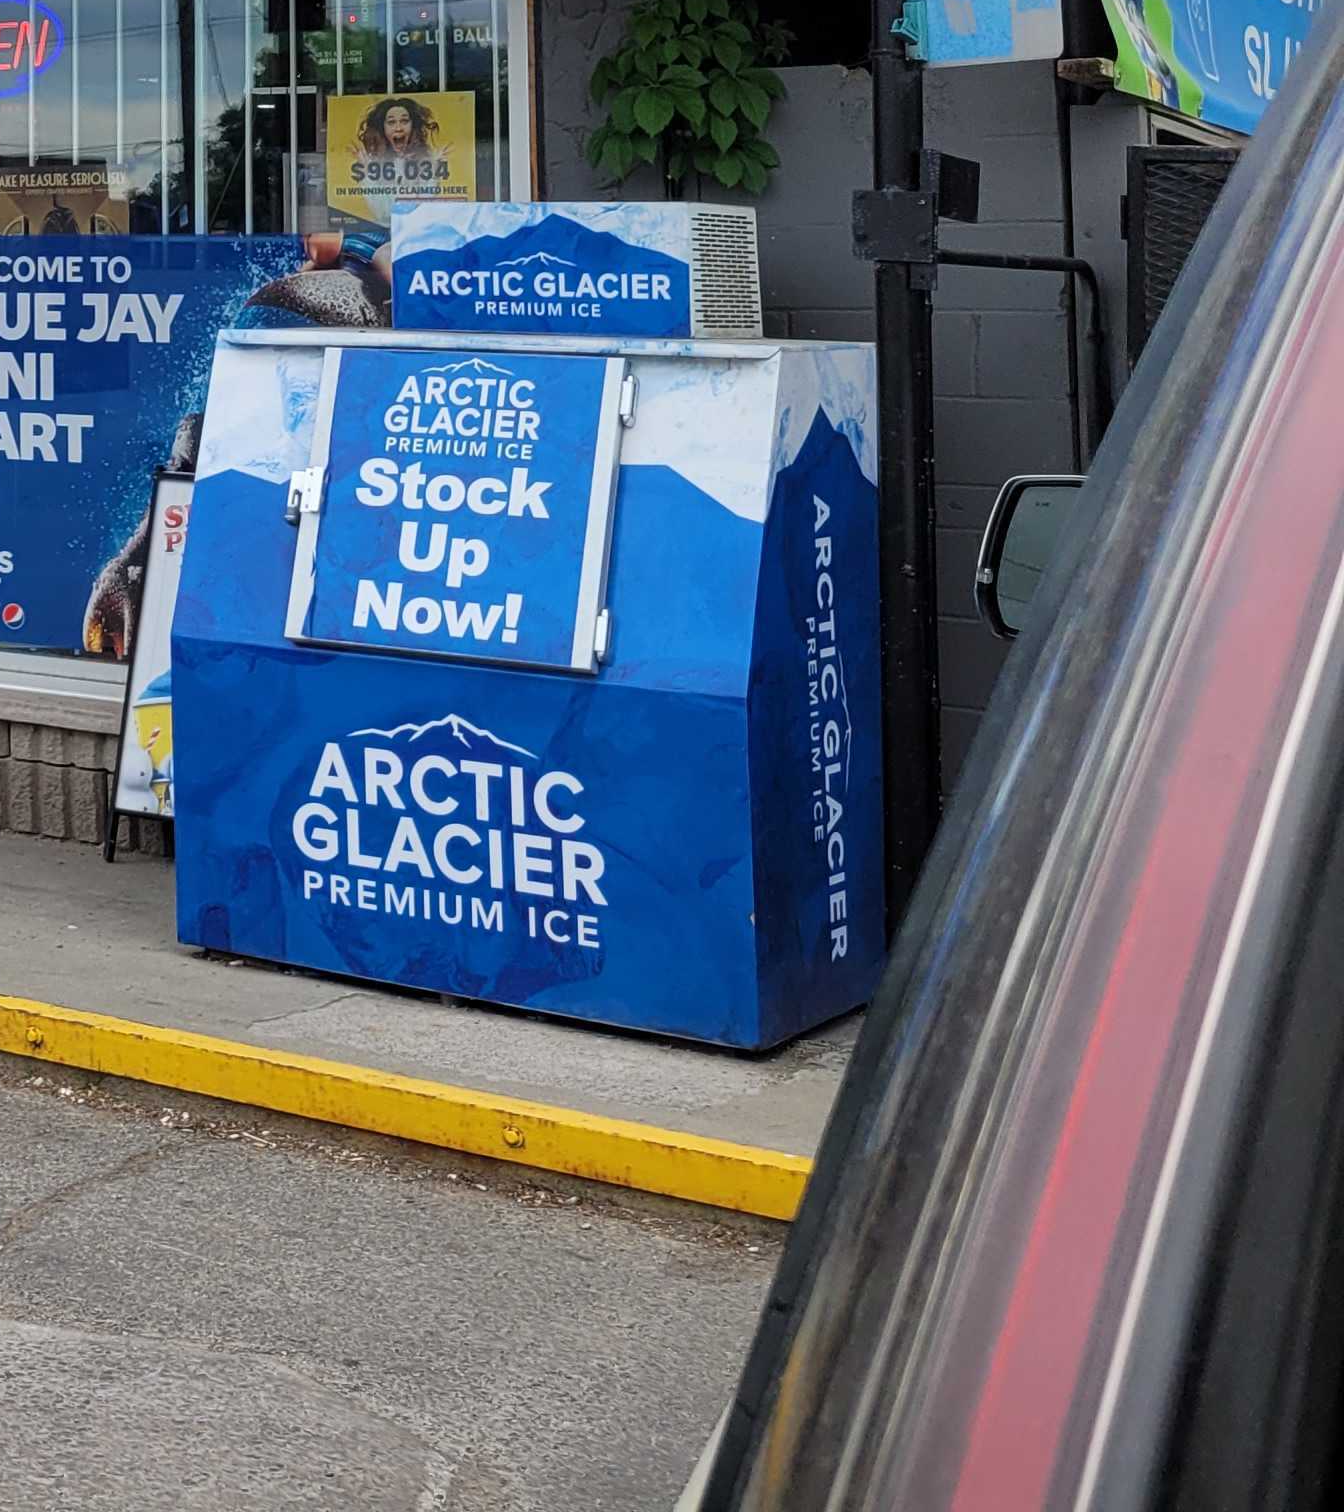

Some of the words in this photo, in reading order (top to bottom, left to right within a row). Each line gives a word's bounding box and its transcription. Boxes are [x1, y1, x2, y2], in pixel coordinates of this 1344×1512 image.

[19, 172, 69, 188] PLEASURE
[336, 187, 347, 196] IN
[348, 186, 397, 196] WINNINGS
[398, 186, 442, 195] CLAIMED
[443, 185, 468, 195] HERE
[350, 159, 450, 183] $96,034
[90, 256, 132, 284] TO
[408, 270, 524, 299] ARCTIC
[533, 272, 672, 300] GLACIER
[77, 292, 185, 344] JAY
[474, 300, 563, 318] PREMIUM
[570, 302, 602, 319] ICE
[396, 374, 536, 409] ARCTIC
[383, 403, 541, 441] GLACIER
[385, 436, 487, 458] PREMIUM
[496, 442, 533, 461] ICE
[355, 457, 553, 520] Stock
[398, 520, 490, 589] Up
[351, 579, 524, 644] Now!
[813, 493, 838, 702] ARCTIC
[805, 615, 821, 773] PREMIUM
[308, 741, 585, 835] ARCTIC
[812, 787, 825, 843] ICE
[292, 802, 609, 907] GLACIER
[822, 718, 849, 963] GLACIER
[303, 869, 504, 933] PREMIUM
[527, 907, 601, 949] ICE
